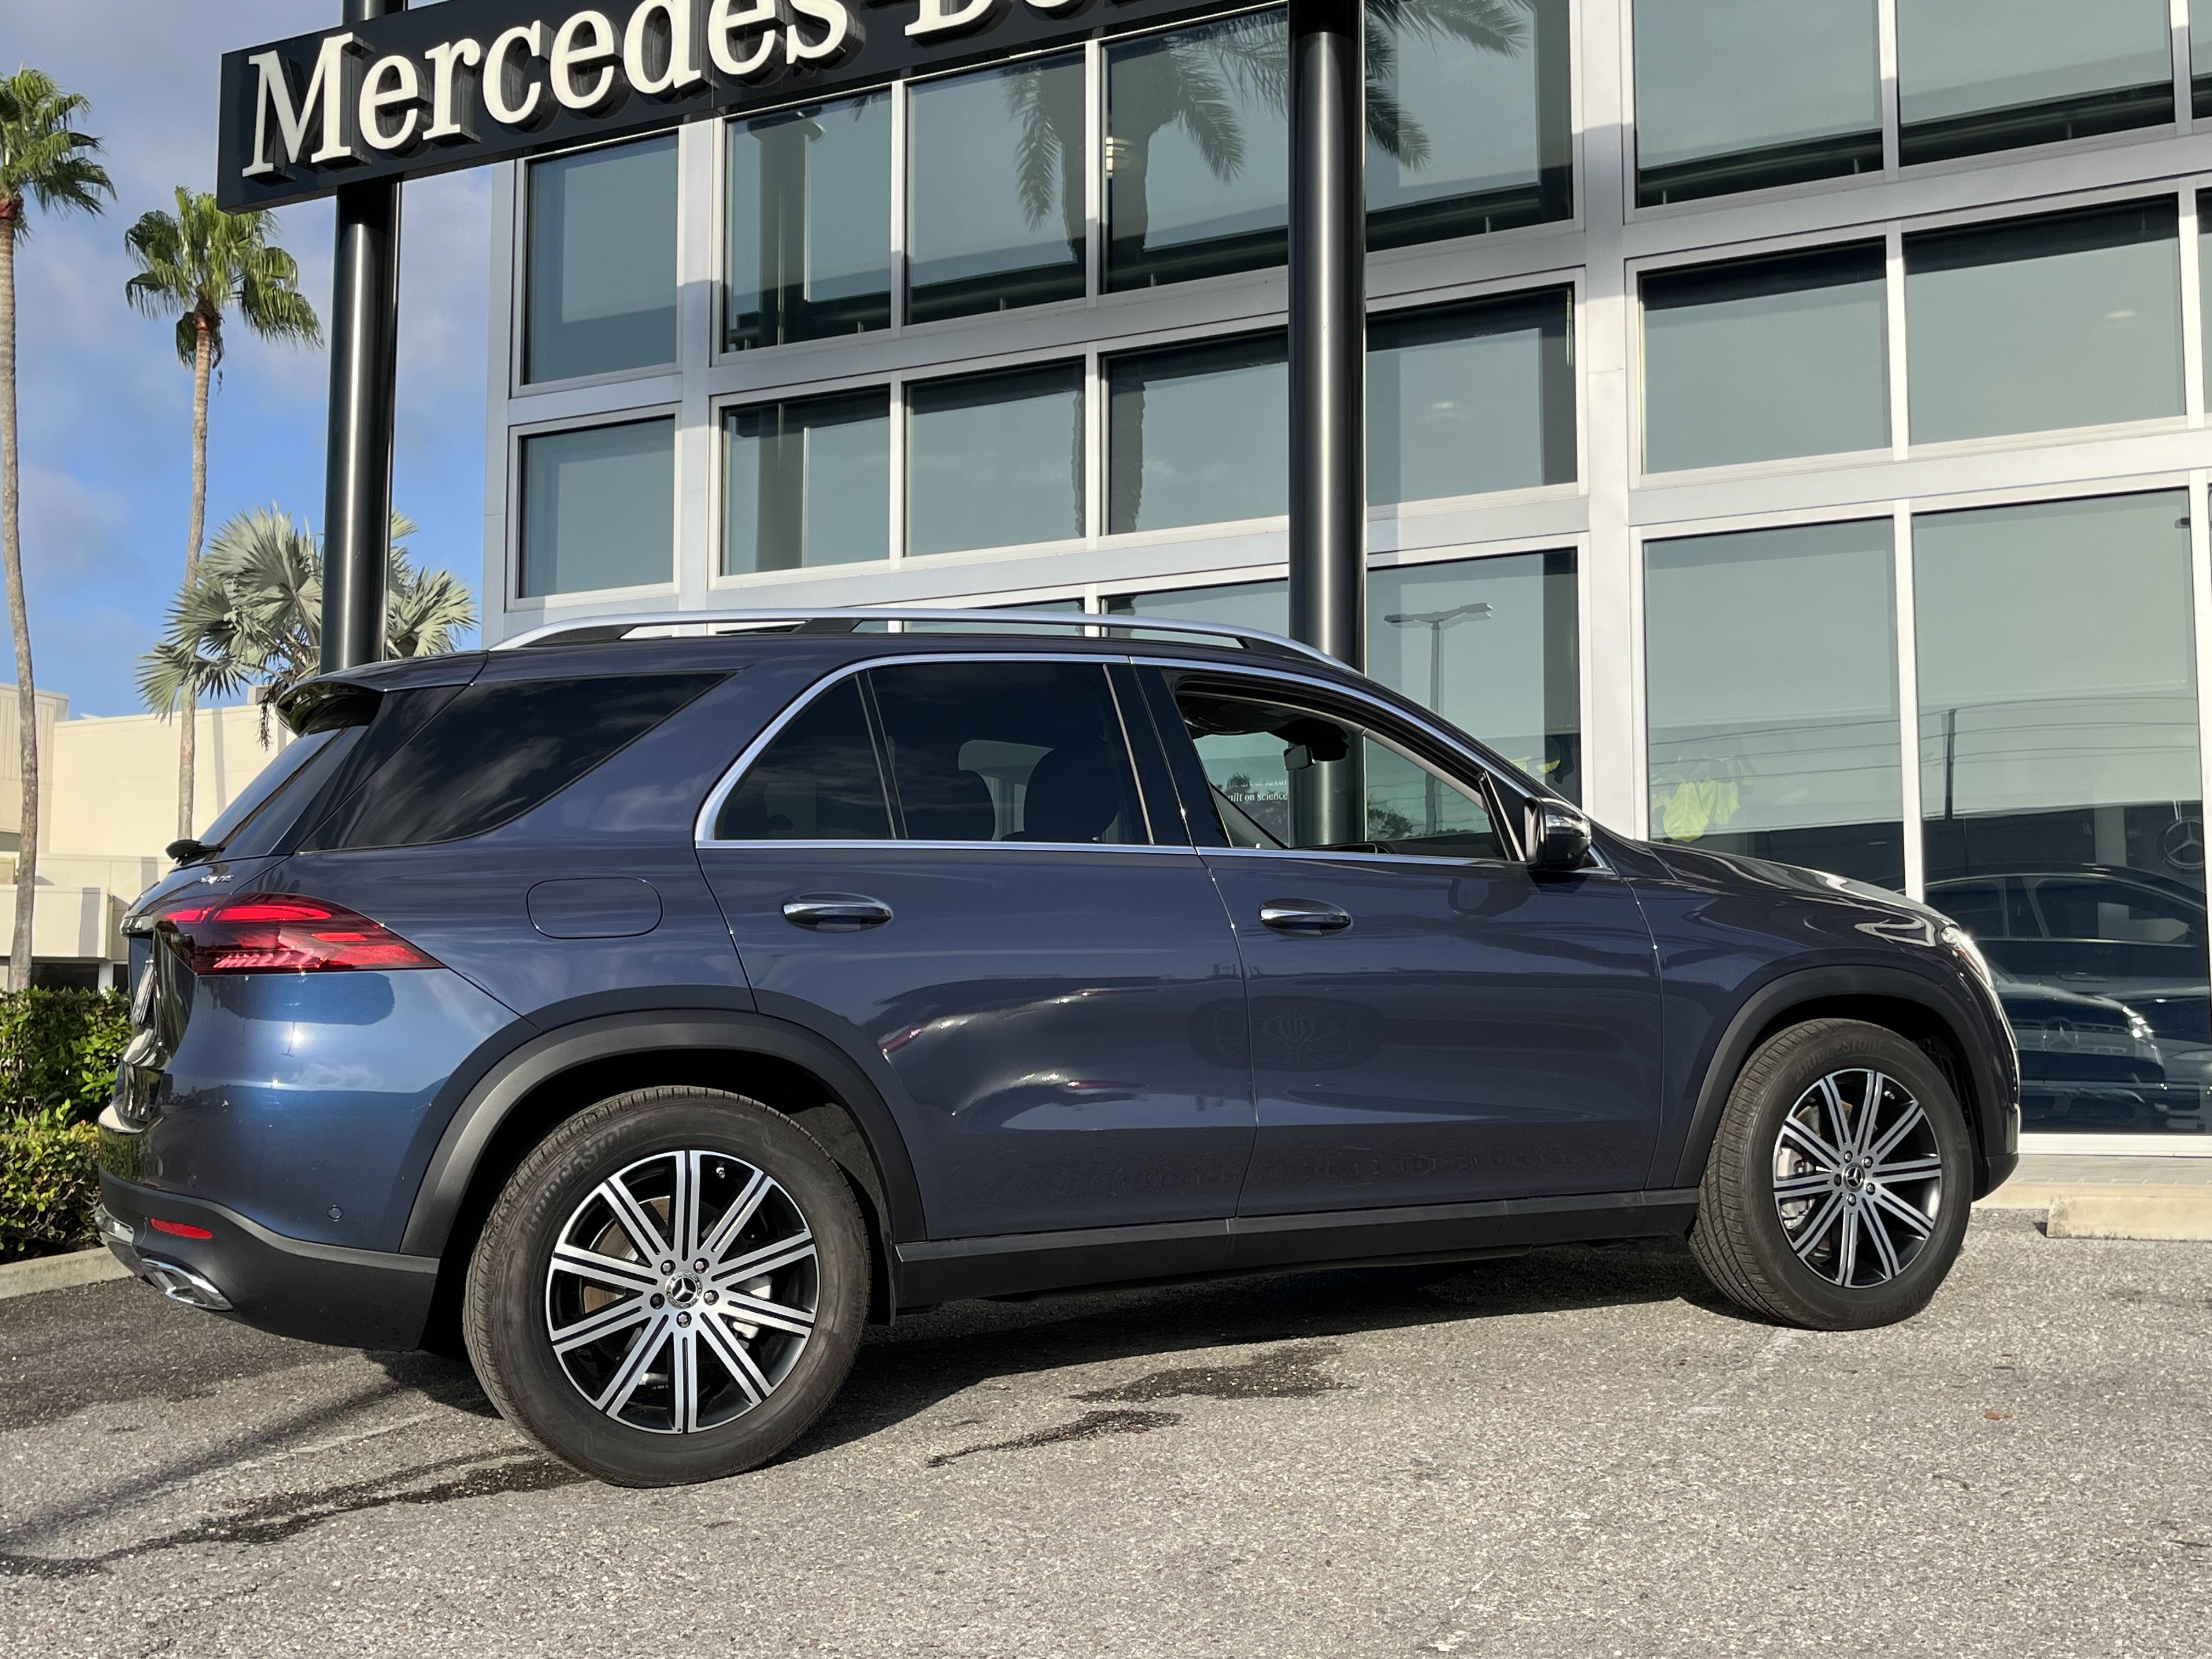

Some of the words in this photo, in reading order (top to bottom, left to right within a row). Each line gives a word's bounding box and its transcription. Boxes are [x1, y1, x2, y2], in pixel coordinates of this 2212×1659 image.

[1265, 777, 1287, 787] luxur
[1227, 793, 1242, 802] uilt
[1257, 792, 1288, 801] science
[1793, 1040, 1886, 1083] BRIDGESTONE
[521, 1117, 654, 1235] BRIDGESTONE
